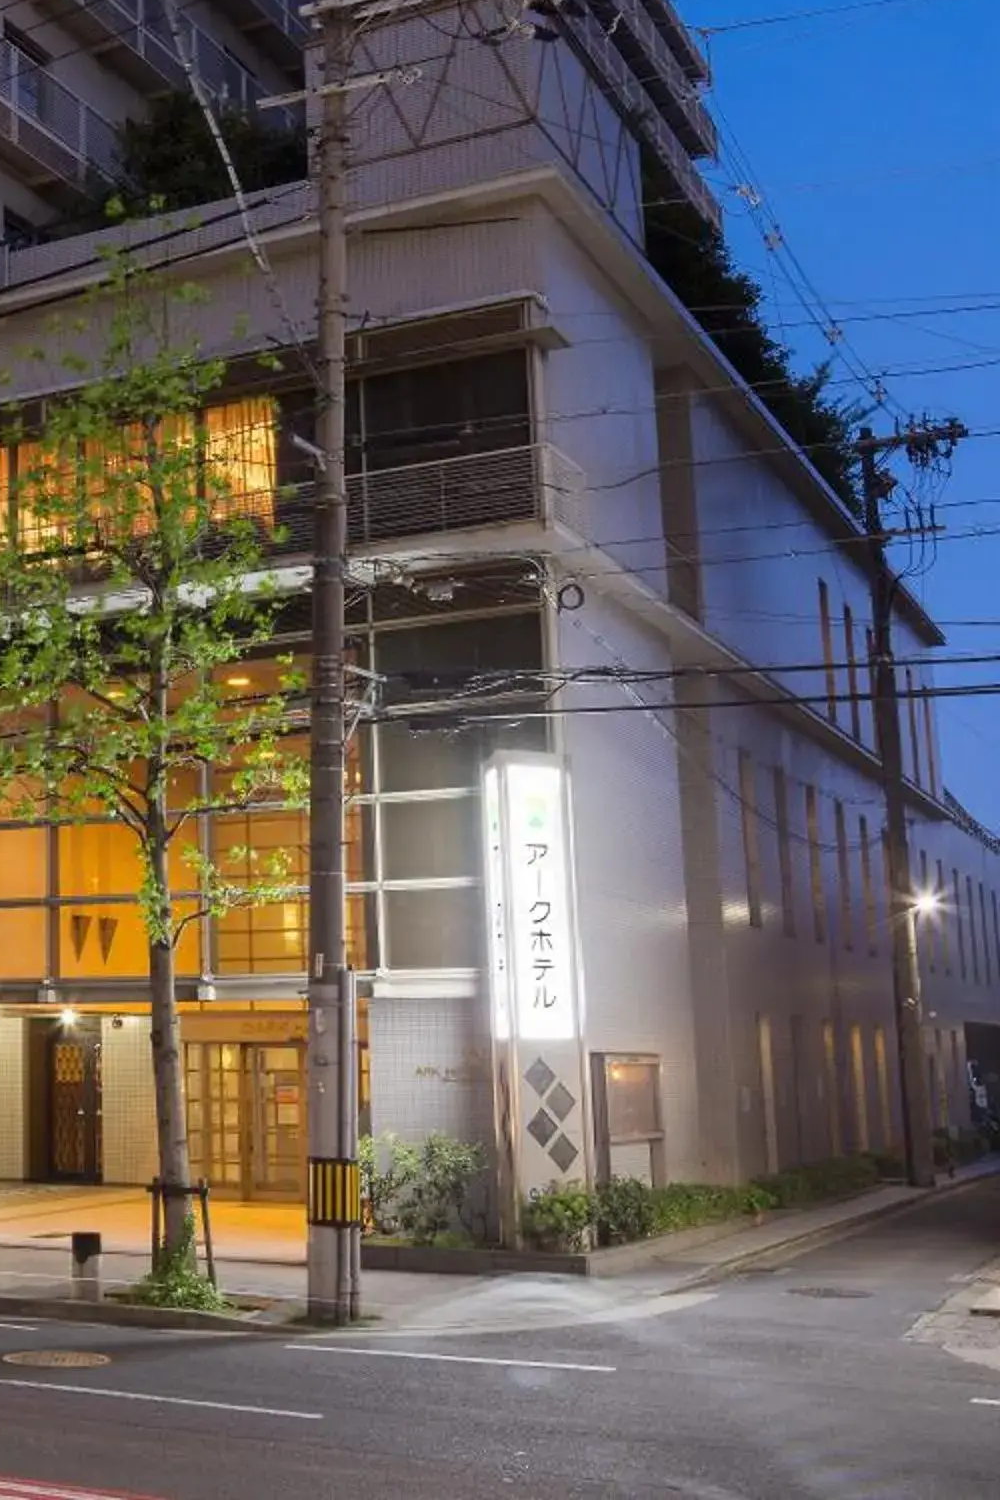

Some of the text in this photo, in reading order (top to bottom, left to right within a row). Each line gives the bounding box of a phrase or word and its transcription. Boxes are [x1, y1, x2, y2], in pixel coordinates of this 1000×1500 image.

[524, 843, 557, 1009] アークホテル
